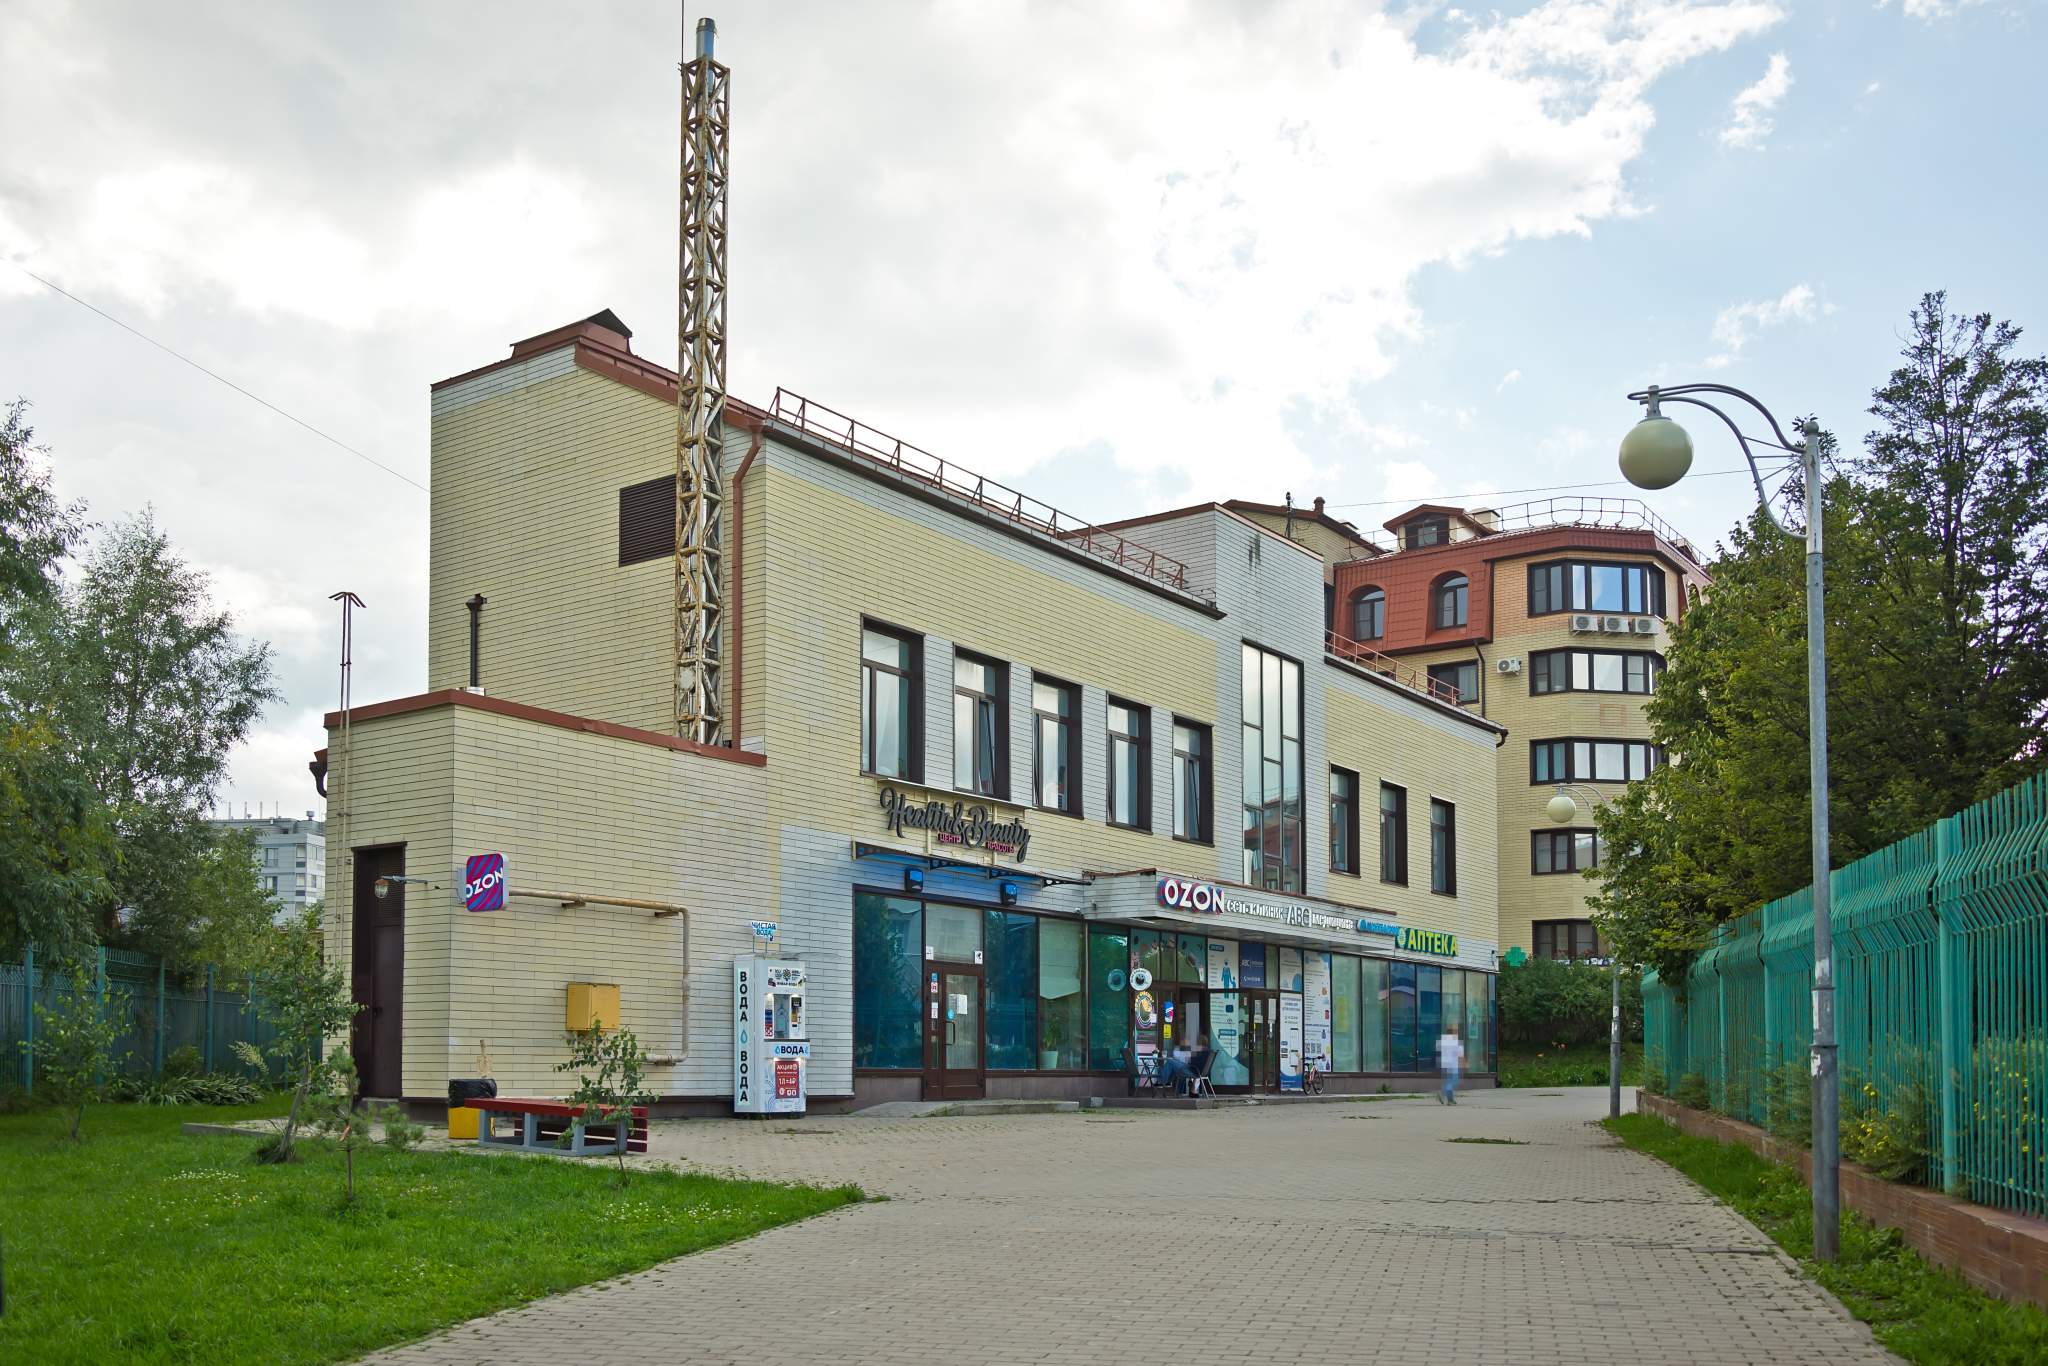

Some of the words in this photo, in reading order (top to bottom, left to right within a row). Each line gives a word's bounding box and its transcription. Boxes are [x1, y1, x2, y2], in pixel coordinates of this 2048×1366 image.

[1164, 879, 1225, 914] OZON
[756, 929, 773, 937] ВОДА
[1408, 929, 1458, 957] АПТЕКА
[739, 971, 749, 1022] ВОДА
[780, 1045, 805, 1056] ВОДА
[739, 1050, 749, 1102] ВОДА
